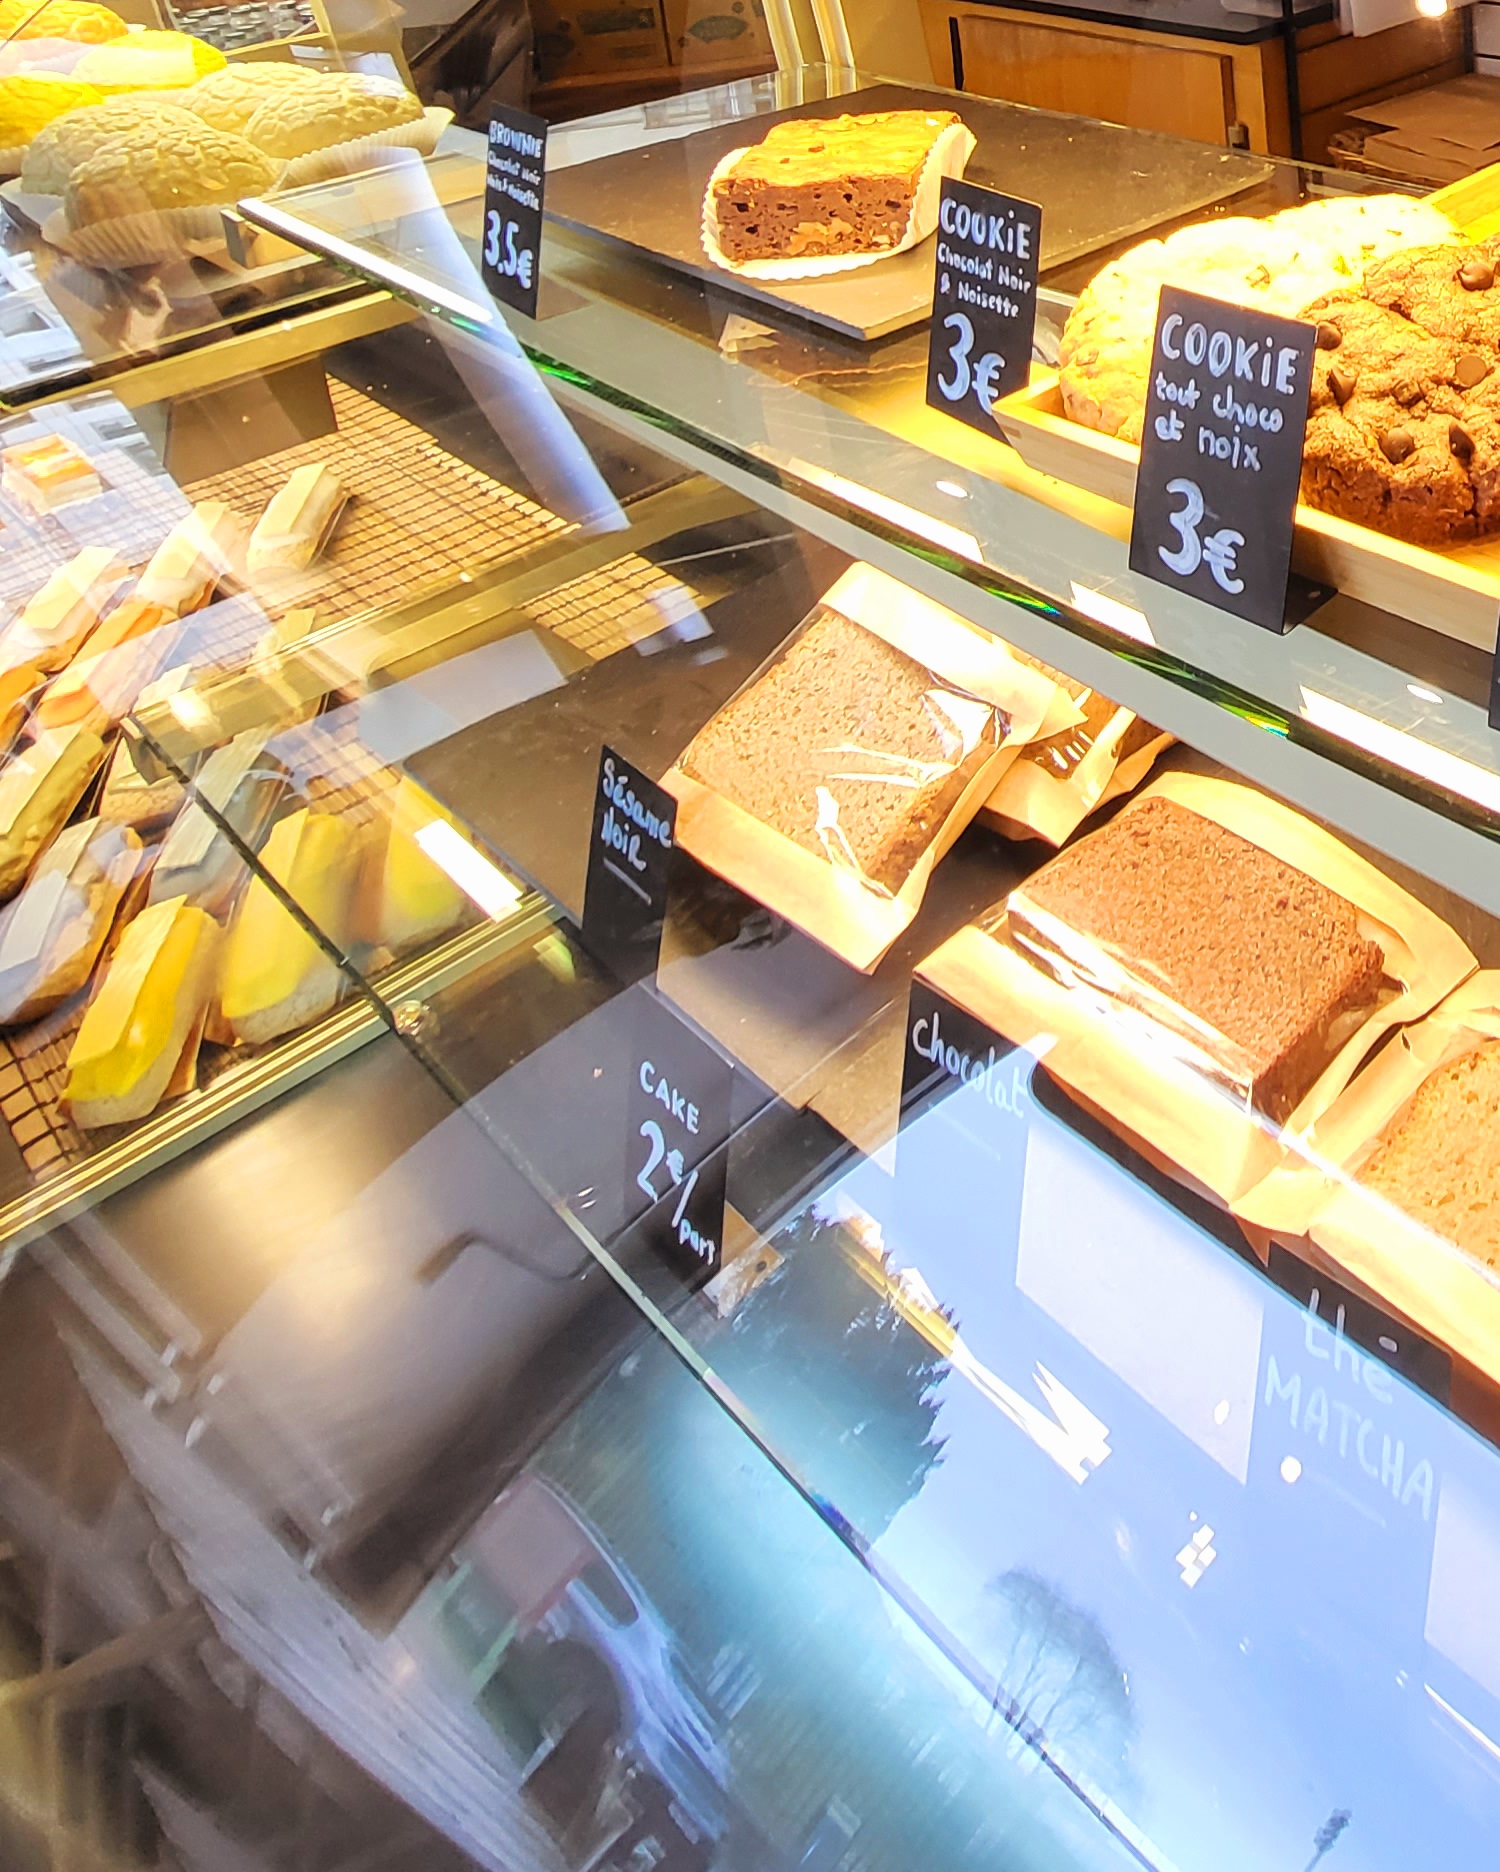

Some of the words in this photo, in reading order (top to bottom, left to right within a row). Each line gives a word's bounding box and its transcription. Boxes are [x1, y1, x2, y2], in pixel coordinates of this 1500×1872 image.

[489, 120, 543, 158] BROWNIE
[485, 210, 533, 289] 3.5€
[941, 197, 1032, 260] COOKIE
[938, 242, 993, 280] Chocolat
[998, 267, 1031, 296] Noir
[958, 281, 1020, 318] Noisette
[937, 312, 1005, 416] 3€
[1161, 313, 1299, 395] COOKIE
[1156, 371, 1200, 410] tout
[1213, 384, 1284, 433] choco
[1199, 426, 1261, 472] noix
[1158, 478, 1246, 594] 3€
[603, 758, 671, 848] Sésame
[639, 1061, 699, 1134] CAKE
[912, 1012, 1030, 1119] Chocolat
[1264, 1355, 1434, 1520] MATCHA
